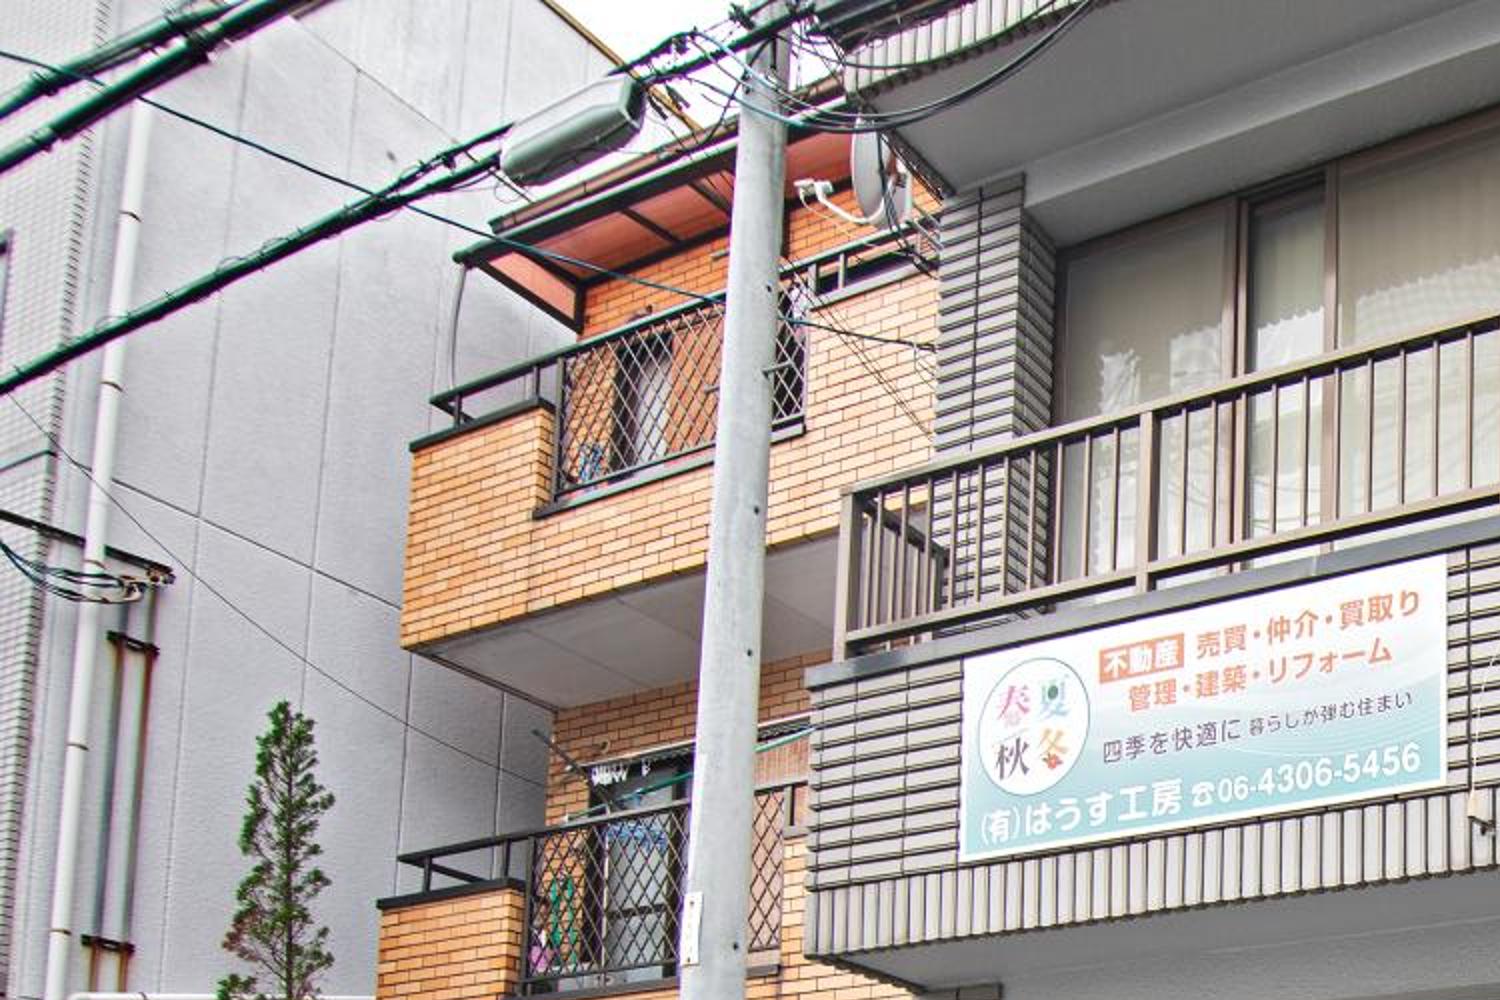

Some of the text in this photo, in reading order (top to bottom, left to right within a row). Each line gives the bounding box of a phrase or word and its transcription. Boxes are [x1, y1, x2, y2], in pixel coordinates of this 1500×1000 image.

[1102, 590, 1420, 678] 不動産 売買・仲介・買取り
[1129, 637, 1392, 712] 管理・建築・リフォーム
[1104, 692, 1413, 763] 四季を快適に 暮らしが弾む住まい
[1217, 742, 1422, 801] 06-4306-5456
